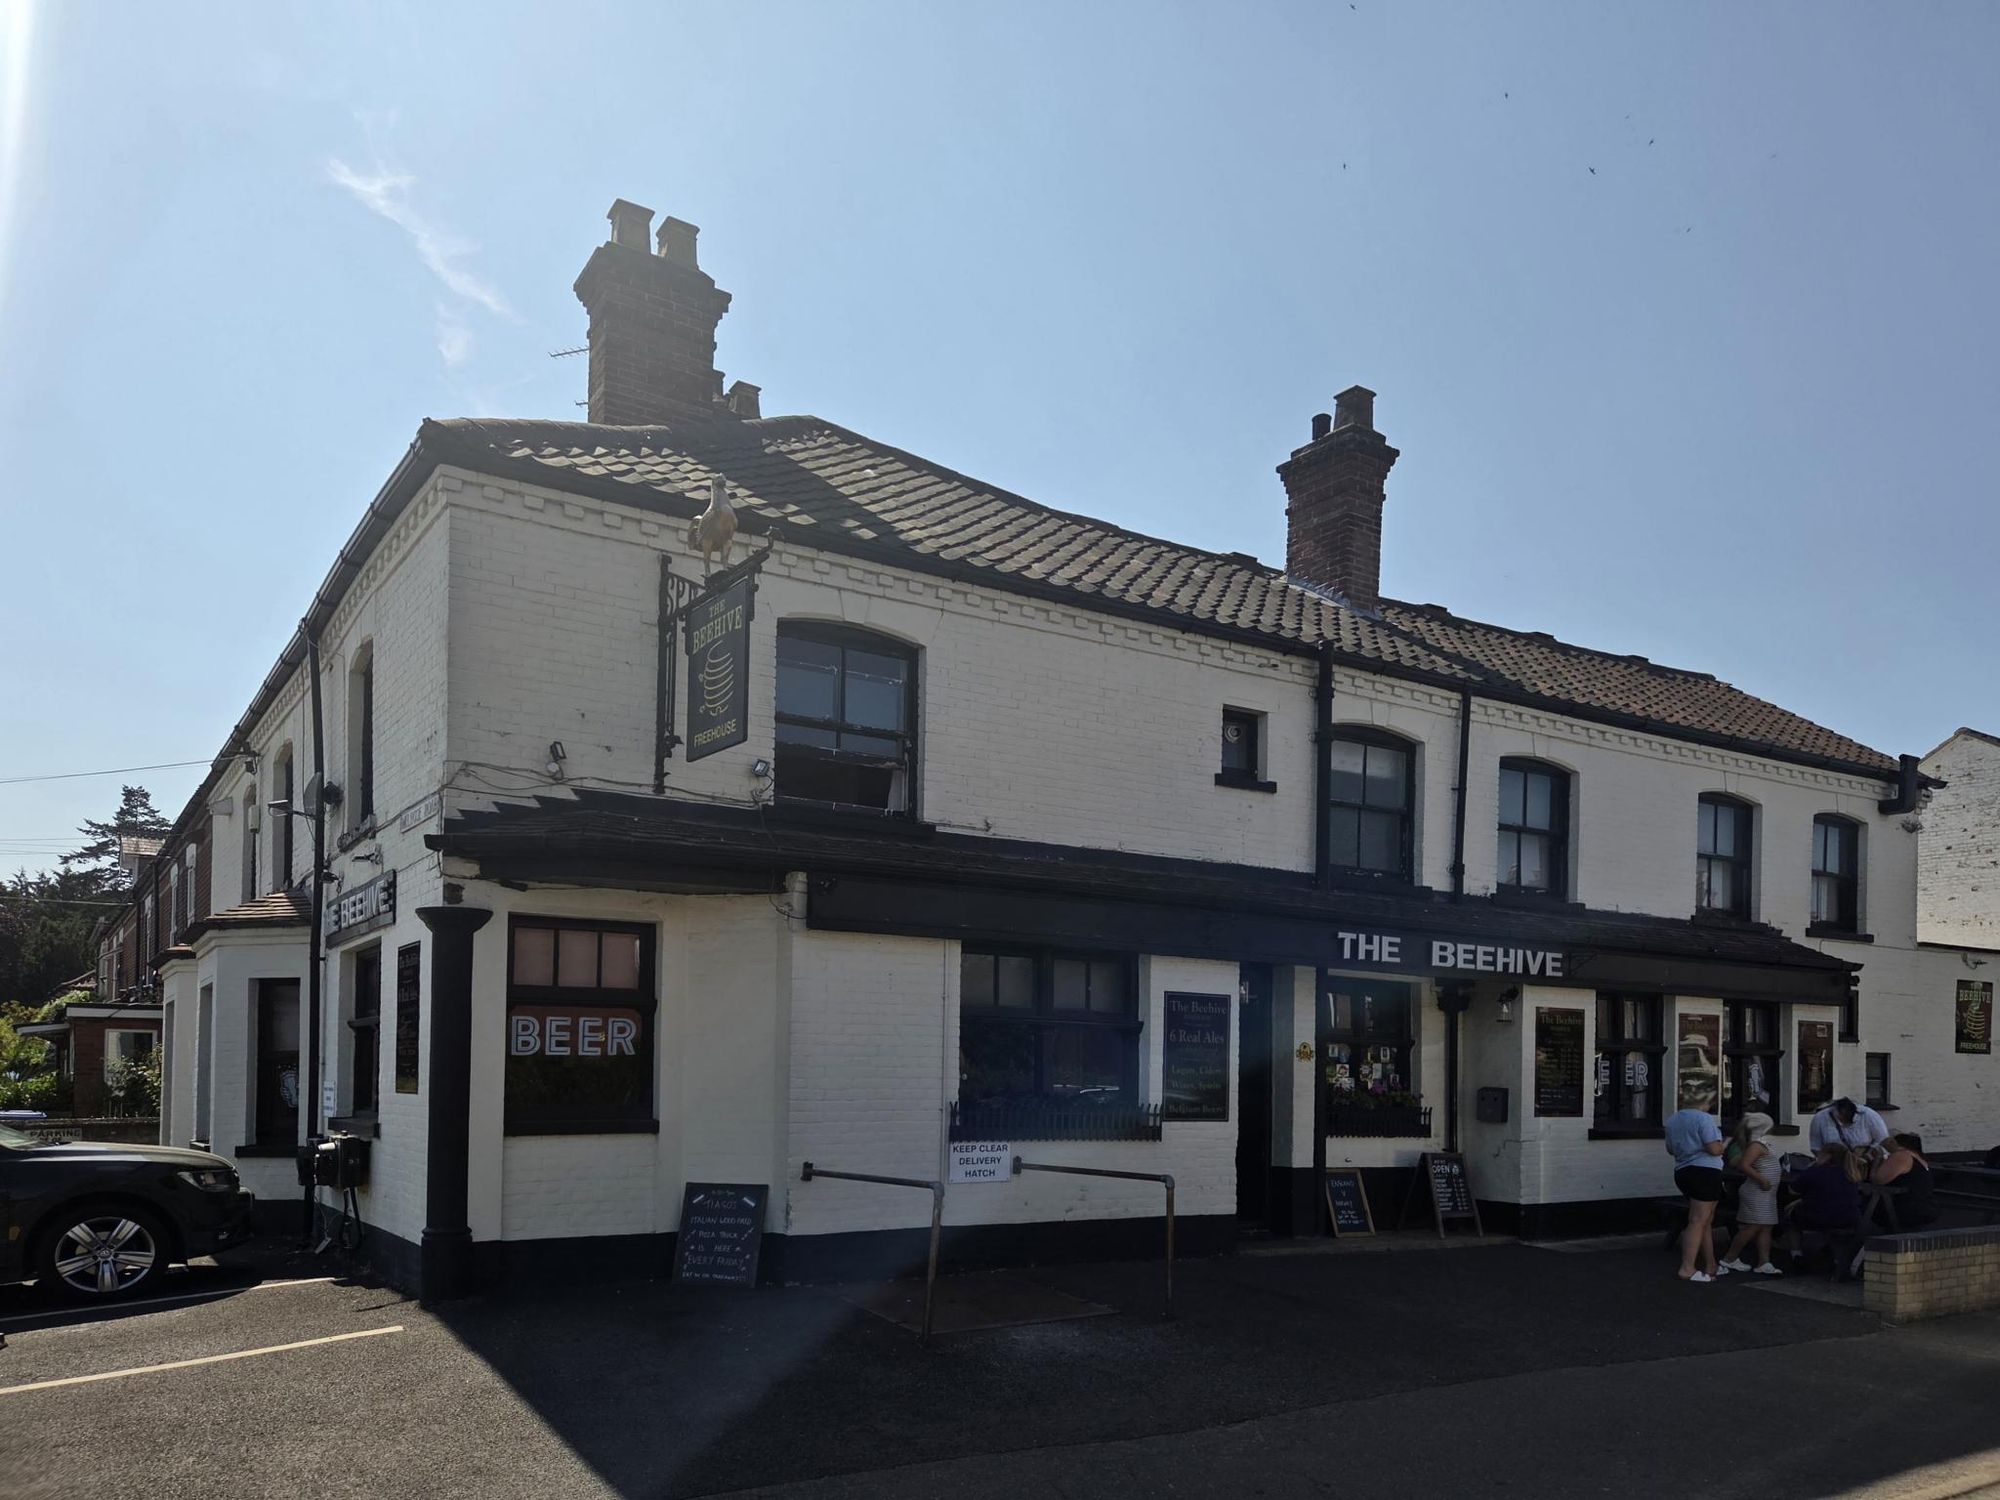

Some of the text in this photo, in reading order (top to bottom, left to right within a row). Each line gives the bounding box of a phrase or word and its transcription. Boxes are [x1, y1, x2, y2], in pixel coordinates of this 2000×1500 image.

[709, 599, 726, 618] THE
[692, 604, 743, 654] BEEHIVE
[693, 718, 737, 748] FREEHOUSE
[341, 880, 390, 929] BEEHIVE
[1337, 931, 1563, 977] THE BEEHIVE
[1170, 1000, 1227, 1015] The Beehive
[511, 1015, 637, 1056] BEER
[1179, 1029, 1201, 1043] Real
[1203, 1030, 1224, 1044] Ales
[30, 1129, 80, 1137] PARKING
[953, 1144, 1008, 1153] KEEP CLEAR
[959, 1156, 1002, 1165] DELIVERY
[965, 1169, 996, 1178] HATCH
[1432, 1164, 1450, 1174] OPEN
